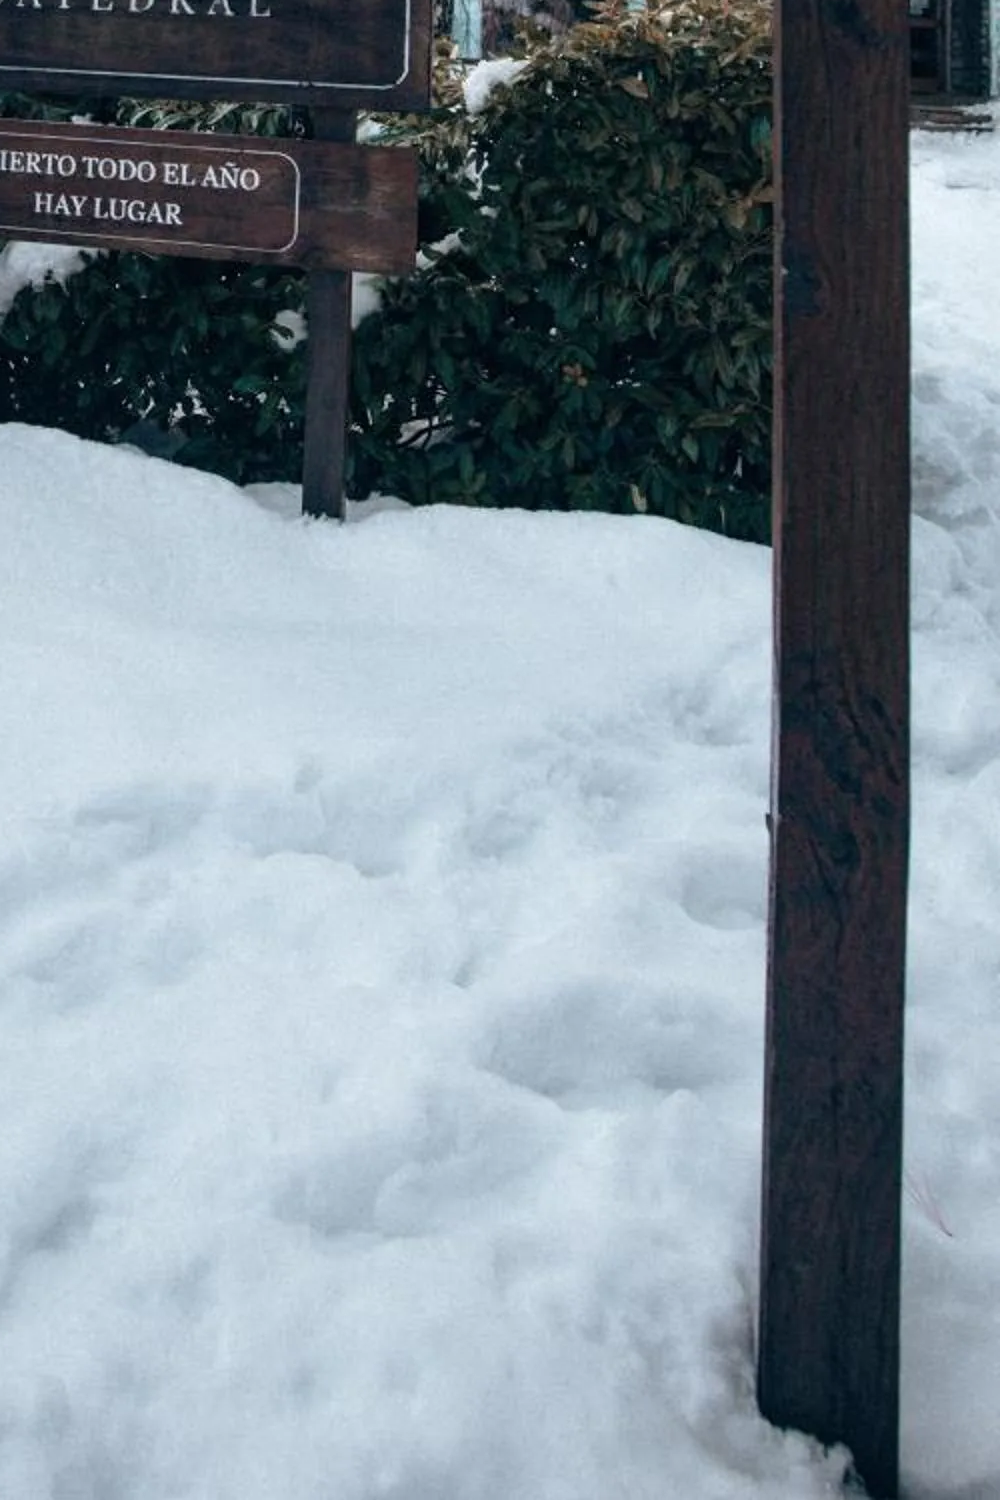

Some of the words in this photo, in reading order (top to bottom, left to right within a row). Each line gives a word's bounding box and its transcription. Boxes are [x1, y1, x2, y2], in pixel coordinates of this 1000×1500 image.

[82, 156, 157, 183] TODO
[164, 164, 197, 187] EL
[201, 161, 260, 191] AÑO
[34, 192, 88, 217] HAY
[95, 198, 183, 225] LUGAR
